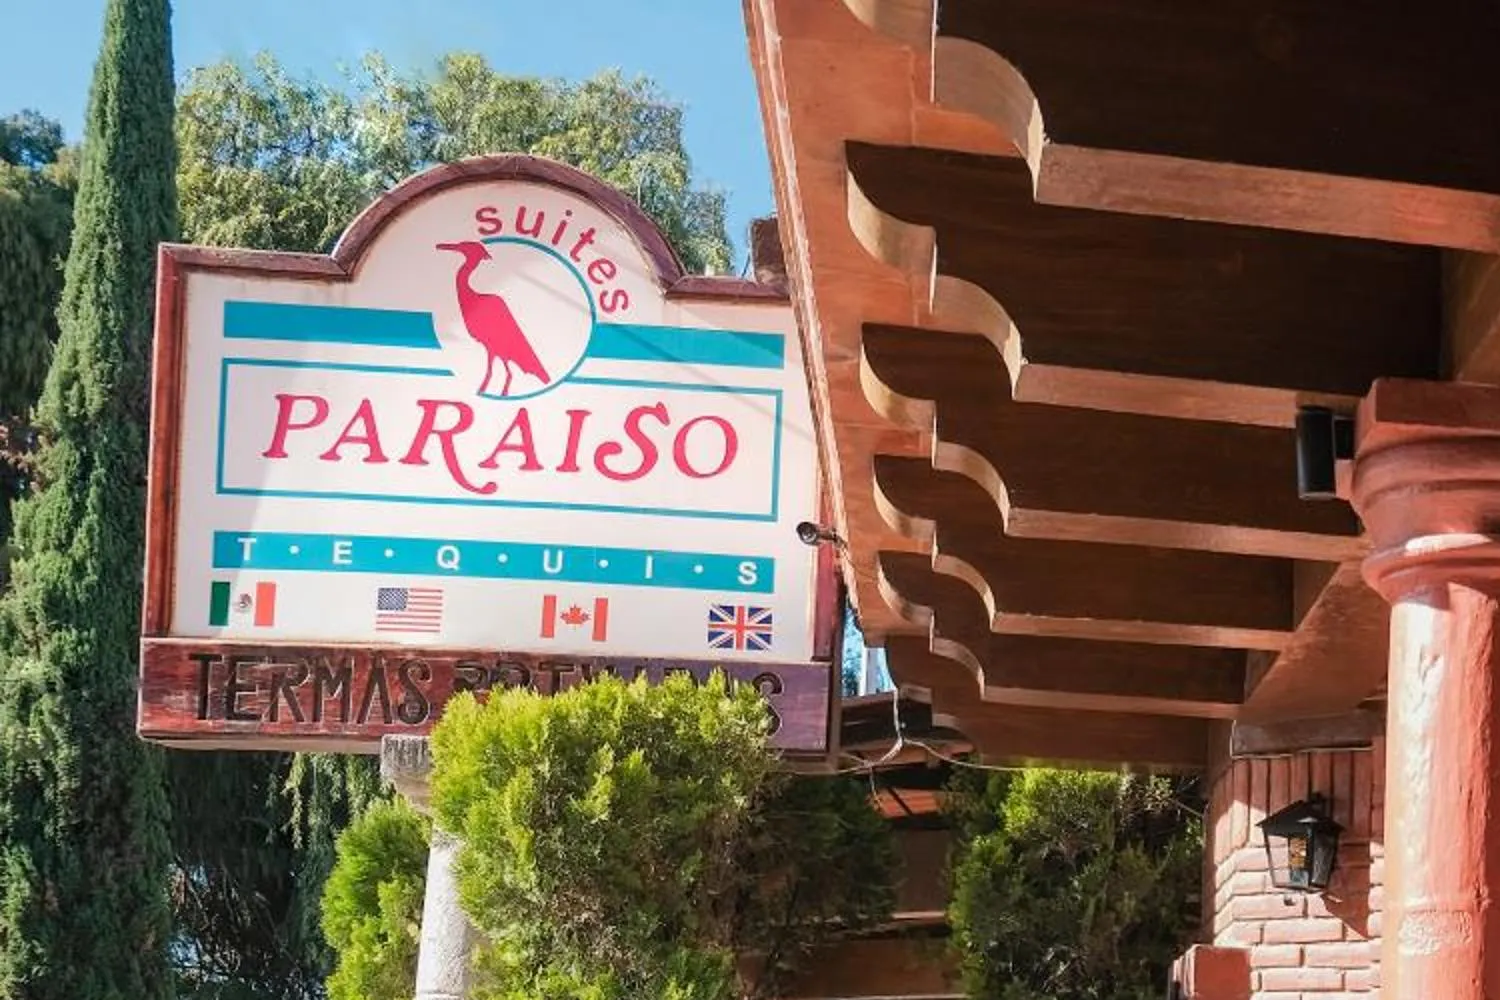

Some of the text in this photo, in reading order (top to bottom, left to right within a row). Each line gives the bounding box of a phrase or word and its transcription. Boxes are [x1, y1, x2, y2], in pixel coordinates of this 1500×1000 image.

[475, 206, 629, 313] suites
[262, 394, 739, 495] PARAISO
[188, 651, 432, 726] TERMAS
